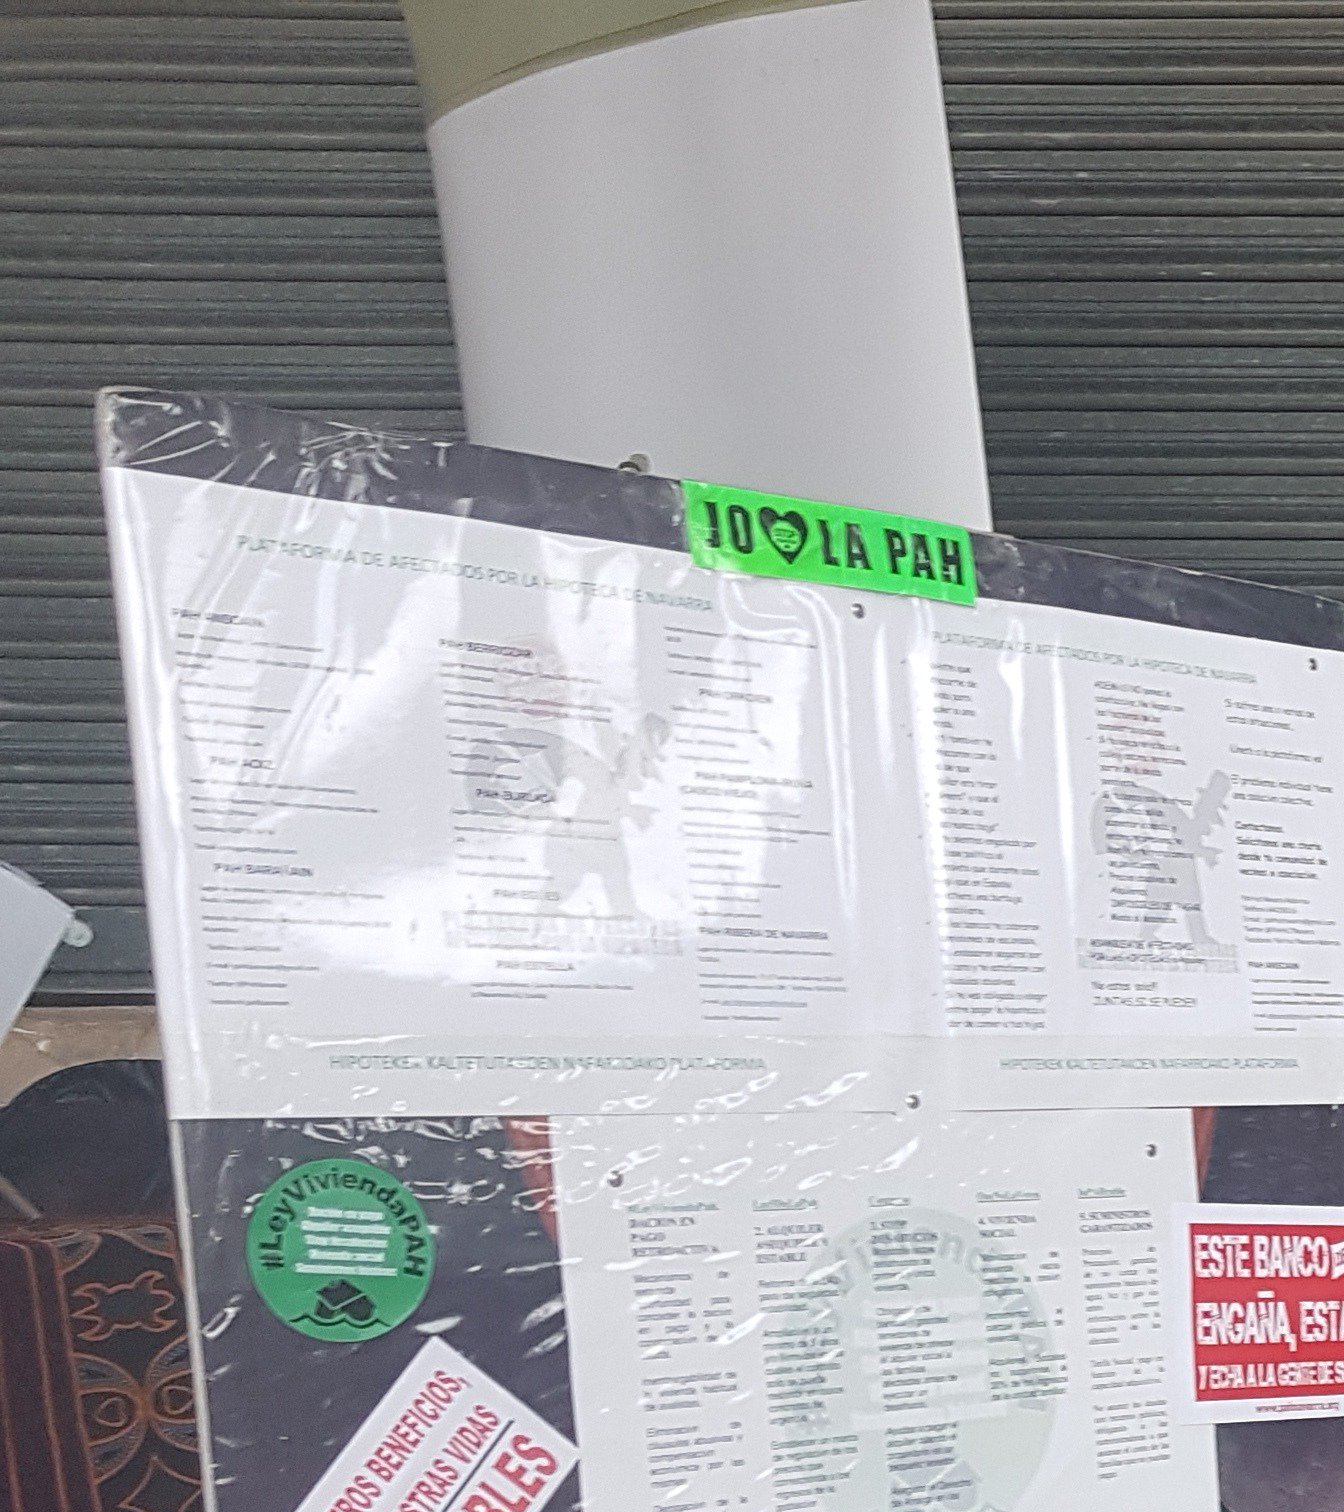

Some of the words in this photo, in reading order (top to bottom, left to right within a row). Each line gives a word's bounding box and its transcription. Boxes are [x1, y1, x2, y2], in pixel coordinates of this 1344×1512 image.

[814, 519, 873, 570] LA
[883, 528, 964, 586] PAH
[260, 1167, 426, 1278] #LeyViviendaPAH
[1194, 1234, 1251, 1278] ESTE
[1253, 1234, 1330, 1278] BANCO
[1196, 1290, 1297, 1352] ENGAÑA,
[1198, 1365, 1208, 1390] Y
[1209, 1365, 1245, 1389] ECHA
[1245, 1364, 1257, 1388] A
[1257, 1363, 1277, 1387] LA
[1278, 1362, 1317, 1386] GENTE
[1317, 1361, 1333, 1386] DE
[366, 1370, 468, 1487] BENEFICIOS,
[443, 1404, 502, 1470] VIDAS
